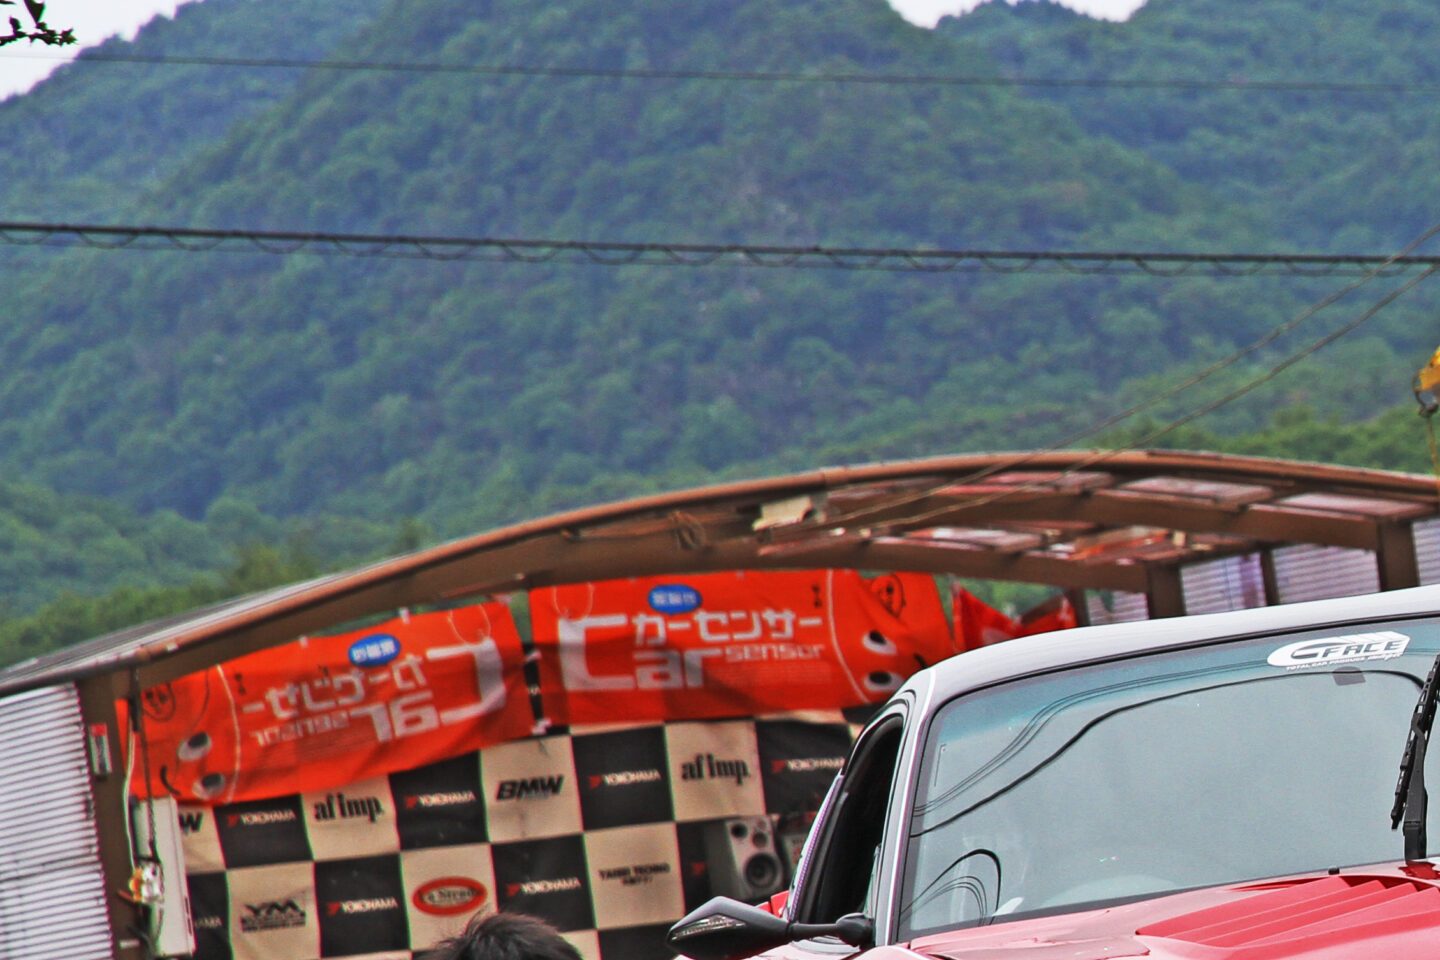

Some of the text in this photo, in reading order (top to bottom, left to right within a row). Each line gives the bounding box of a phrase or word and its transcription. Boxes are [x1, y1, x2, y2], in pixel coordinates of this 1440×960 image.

[632, 608, 824, 646] カーセンサー
[558, 613, 825, 691] Car sensor
[604, 769, 661, 786] YOKOHAMA
[496, 774, 563, 801] BMW
[419, 790, 476, 807] YOKOHAMA
[240, 809, 296, 825] YOKOHAMA
[521, 877, 581, 894] YOKOHAMA
[341, 897, 398, 914] YOKOHAMA
